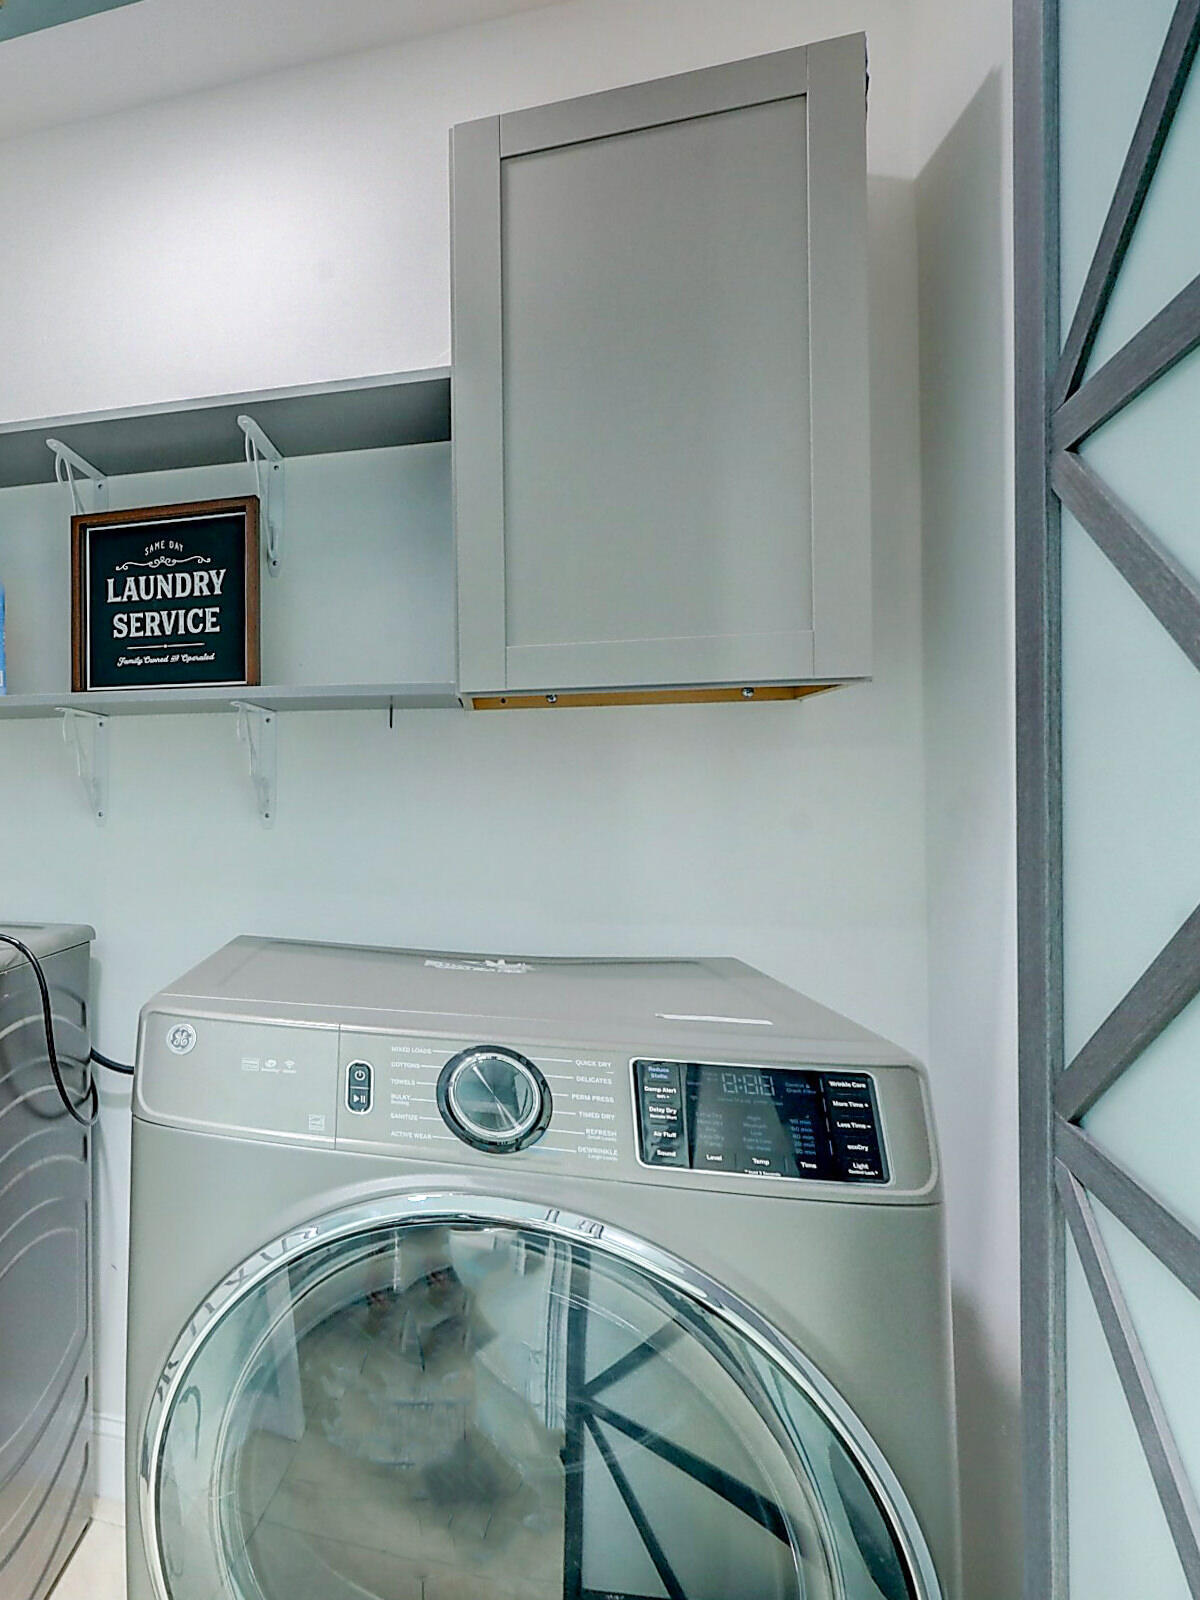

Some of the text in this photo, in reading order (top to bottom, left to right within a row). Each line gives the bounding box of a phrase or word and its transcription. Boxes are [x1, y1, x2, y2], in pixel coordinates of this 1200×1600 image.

[144, 539, 184, 556] SAME DAY
[106, 568, 227, 603] LAUNDRY
[112, 606, 221, 638] SERVICE
[116, 656, 143, 668] Family
[143, 655, 170, 664] Owned
[181, 652, 216, 664] Operated
[575, 1059, 598, 1068] QUICK
[391, 1078, 416, 1086] TOWELS
[575, 1075, 613, 1085] DELICATES
[828, 1080, 852, 1088] Wrinkle
[644, 1085, 662, 1094] Damp
[571, 1093, 615, 1103] PERM PRESS
[578, 1111, 600, 1119] TIMED
[648, 1106, 677, 1115] Delay Dry
[585, 1128, 617, 1137] REFRESH
[577, 1146, 618, 1156] DEWRINKLE
[847, 1144, 869, 1152] ecoDry
[656, 1149, 677, 1157] Sound
[706, 1153, 723, 1161] Level
[752, 1157, 770, 1166] Temp
[800, 1161, 817, 1169] Time
[852, 1162, 869, 1170] Light
